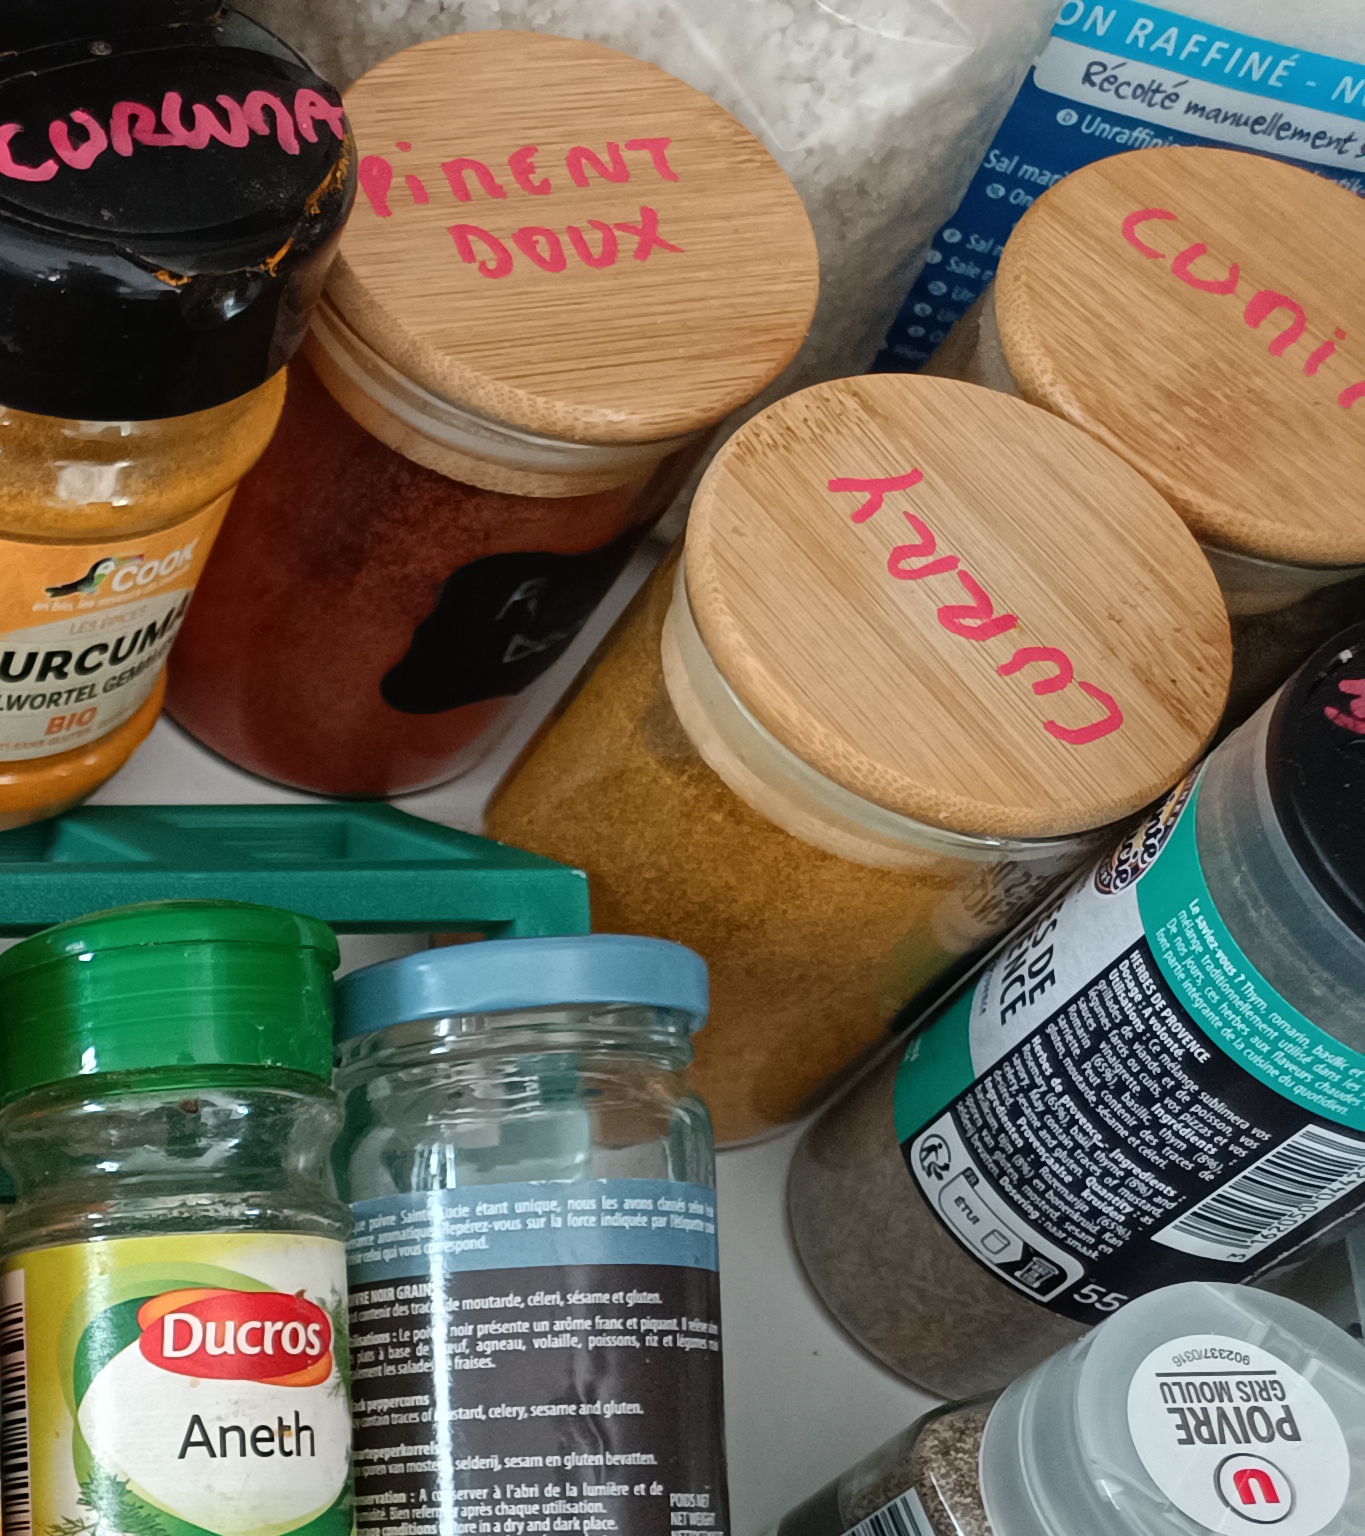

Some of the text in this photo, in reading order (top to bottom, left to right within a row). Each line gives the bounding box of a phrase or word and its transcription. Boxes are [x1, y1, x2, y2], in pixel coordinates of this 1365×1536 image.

[1126, 16, 1300, 88] RAFFINÉ
[1081, 59, 1358, 156] Récolté manuellement
[983, 149, 1019, 175] Sal
[447, 206, 686, 279] DOUX
[111, 537, 200, 592] COOK
[828, 467, 1124, 745] CURRY
[44, 706, 98, 736] BIO
[1119, 959, 1185, 1061] Dosage volonté.
[1129, 949, 1211, 1064] HERBES DE PROVENCE
[1166, 917, 1360, 1108] De jours, ces herbes aux flaveurs chaudes
[1178, 909, 1342, 1083] mélange traditionnellement utilisé dans
[1163, 950, 1349, 1117] partie intégrante de cuisine du quotidien.
[1240, 980, 1269, 1015] Thym,
[1268, 1011, 1312, 1050] romarin,
[1312, 1045, 1350, 1071] basilic
[1108, 968, 1272, 1141] Utilisations mélange sublimera vos
[1132, 1041, 1162, 1075] viande
[1189, 1103, 1233, 1137] poisson,
[1150, 1102, 1217, 1155] Ingrédients
[462, 1294, 525, 1311] moutarde,
[527, 1291, 564, 1308] céleri,
[567, 1291, 611, 1305] sésame
[1073, 1284, 1129, 1311] 55
[162, 1311, 322, 1359] Ducros
[475, 1332, 640, 1354] agneau, volaille, poissons,
[476, 1318, 530, 1338] présente
[488, 1401, 644, 1421] celery, sesame and gluten.
[1159, 1379, 1286, 1404] GRIS MOULU
[177, 1409, 316, 1460] Aneth
[1167, 1404, 1302, 1446] POIVRE
[455, 1454, 502, 1472] selderij,
[504, 1455, 543, 1469] sesam
[563, 1452, 604, 1470] gluten
[494, 1501, 540, 1519] chaque
